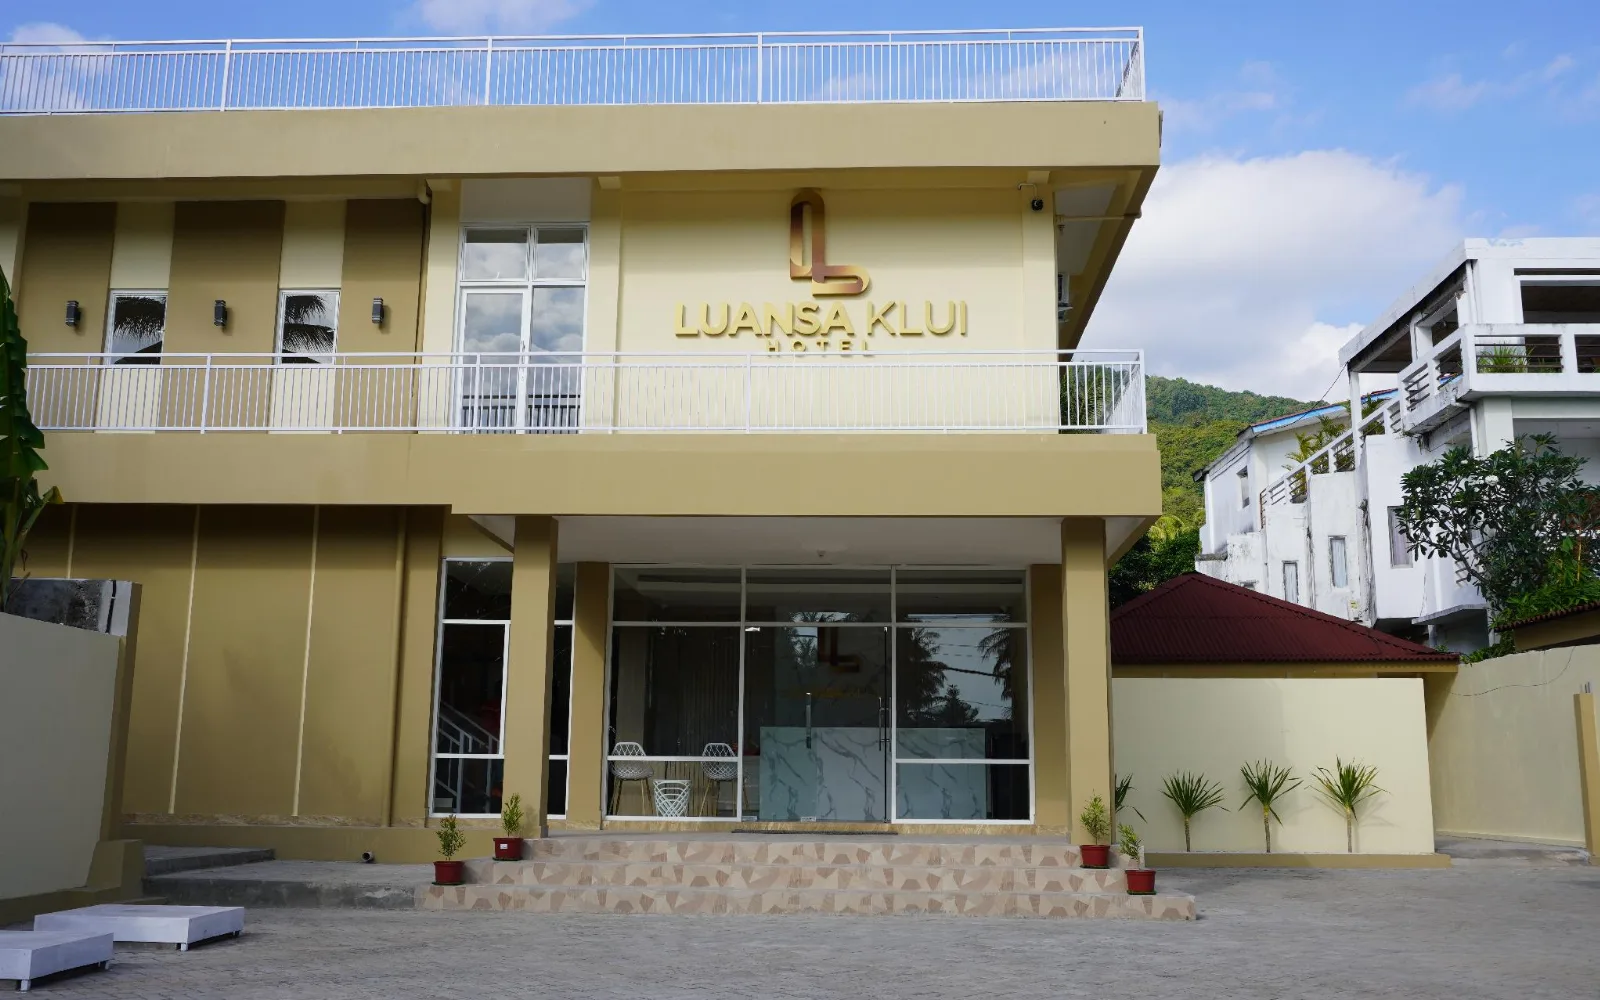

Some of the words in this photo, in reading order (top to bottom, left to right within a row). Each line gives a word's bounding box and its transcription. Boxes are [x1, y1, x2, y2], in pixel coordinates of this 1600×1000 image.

[674, 300, 855, 337] LUANSA
[866, 299, 968, 336] KLUI
[766, 339, 874, 356] HOTEL
